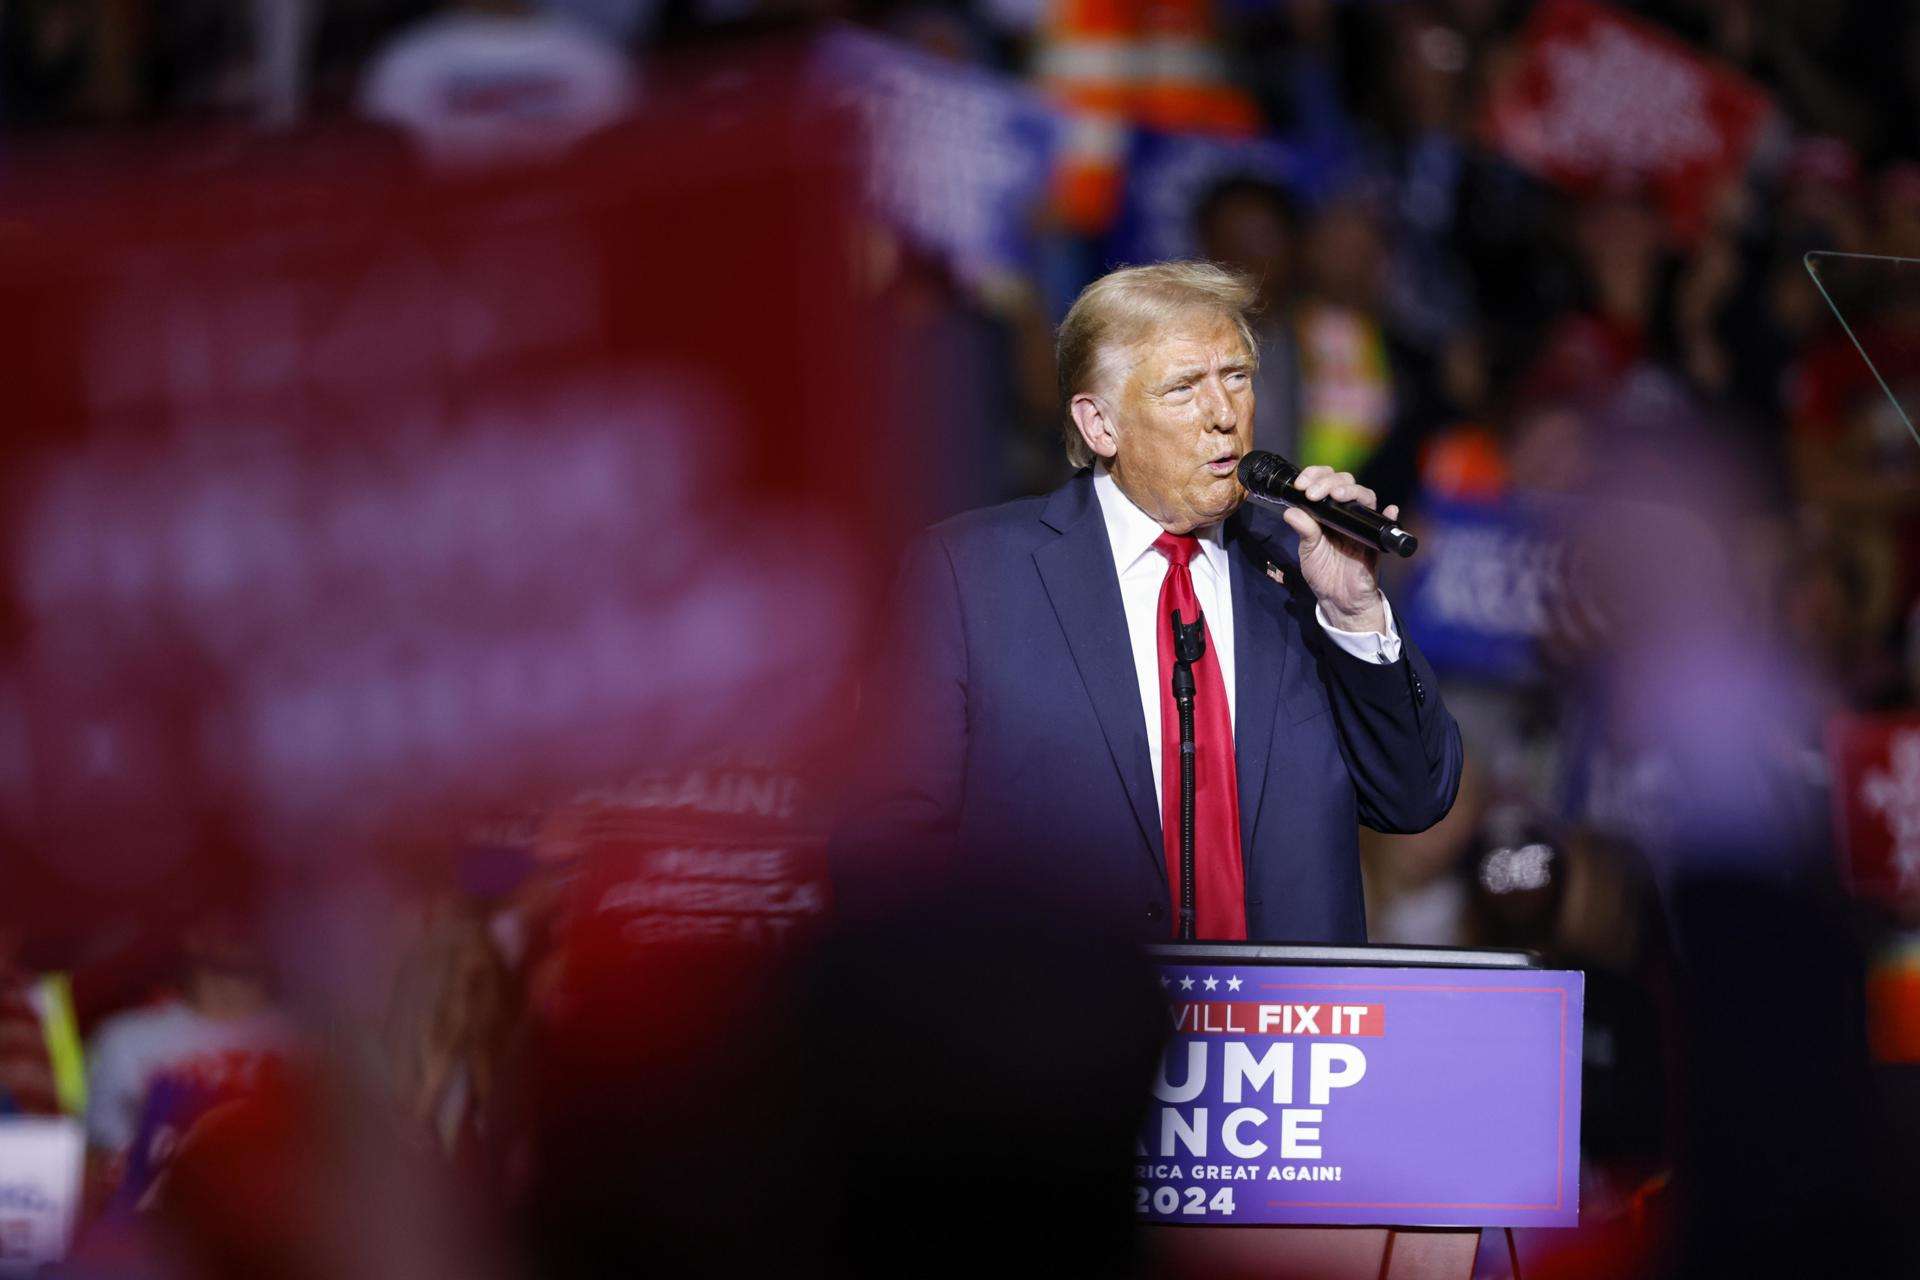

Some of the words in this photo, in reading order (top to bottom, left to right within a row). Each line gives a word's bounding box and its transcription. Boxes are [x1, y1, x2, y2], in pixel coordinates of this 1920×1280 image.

[1258, 1004, 1320, 1034] FIX
[1331, 1006, 1368, 1035] IT
[1152, 1041, 1367, 1105] UMP
[1136, 1107, 1323, 1159] NCE
[1134, 1165, 1183, 1180] RICA
[1191, 1165, 1260, 1180] GREAT
[1267, 1166, 1342, 1181] AGAIN!
[1134, 1186, 1236, 1215] 2024
